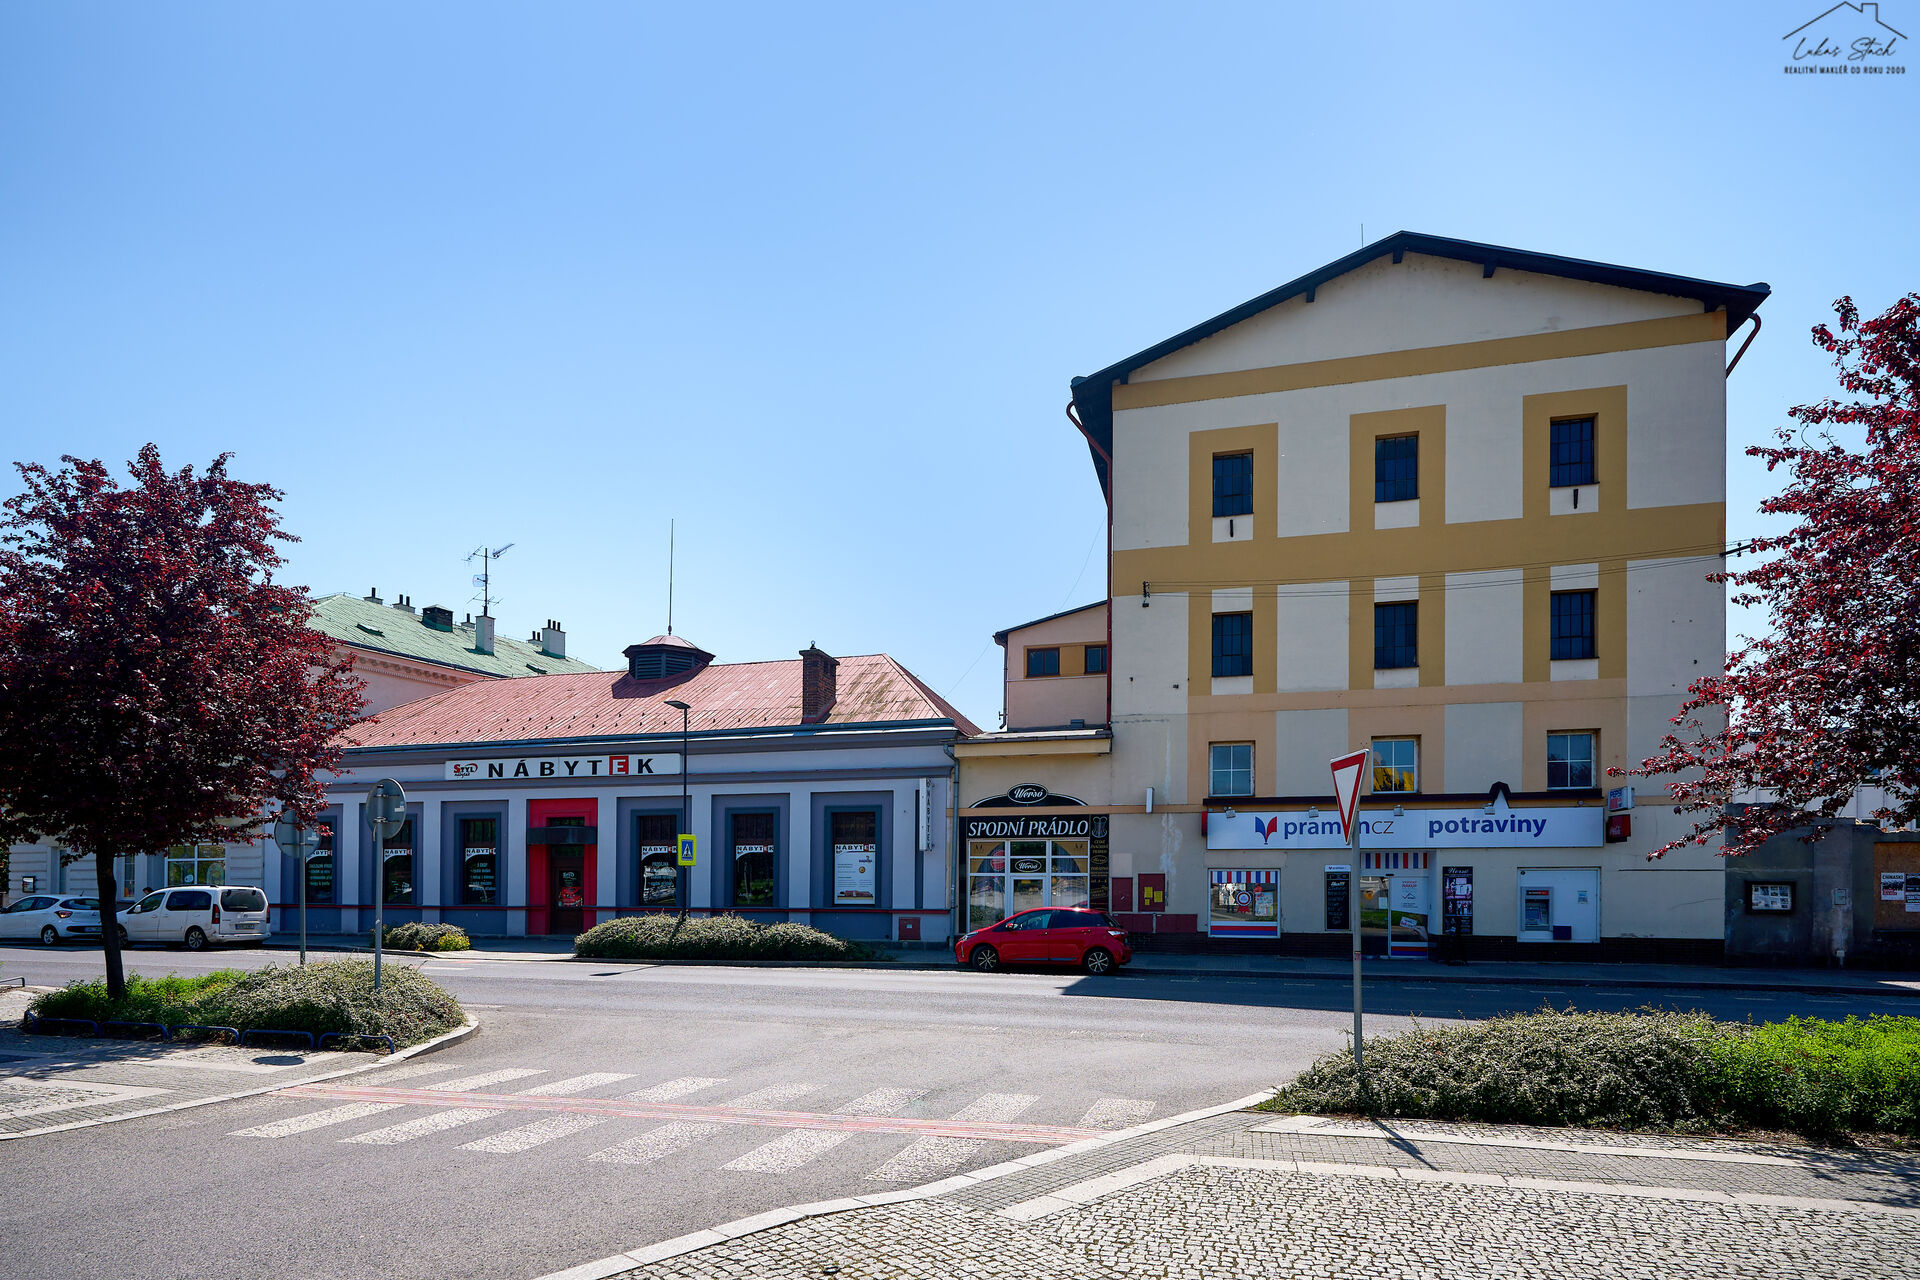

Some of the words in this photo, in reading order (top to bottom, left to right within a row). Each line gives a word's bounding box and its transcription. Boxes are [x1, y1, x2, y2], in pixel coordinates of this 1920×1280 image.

[488, 757, 655, 778] NÁBYTEK
[968, 817, 1026, 837] SPODNÍ
[1027, 816, 1089, 837] PRÁDLO
[1429, 814, 1547, 838] potraviny
